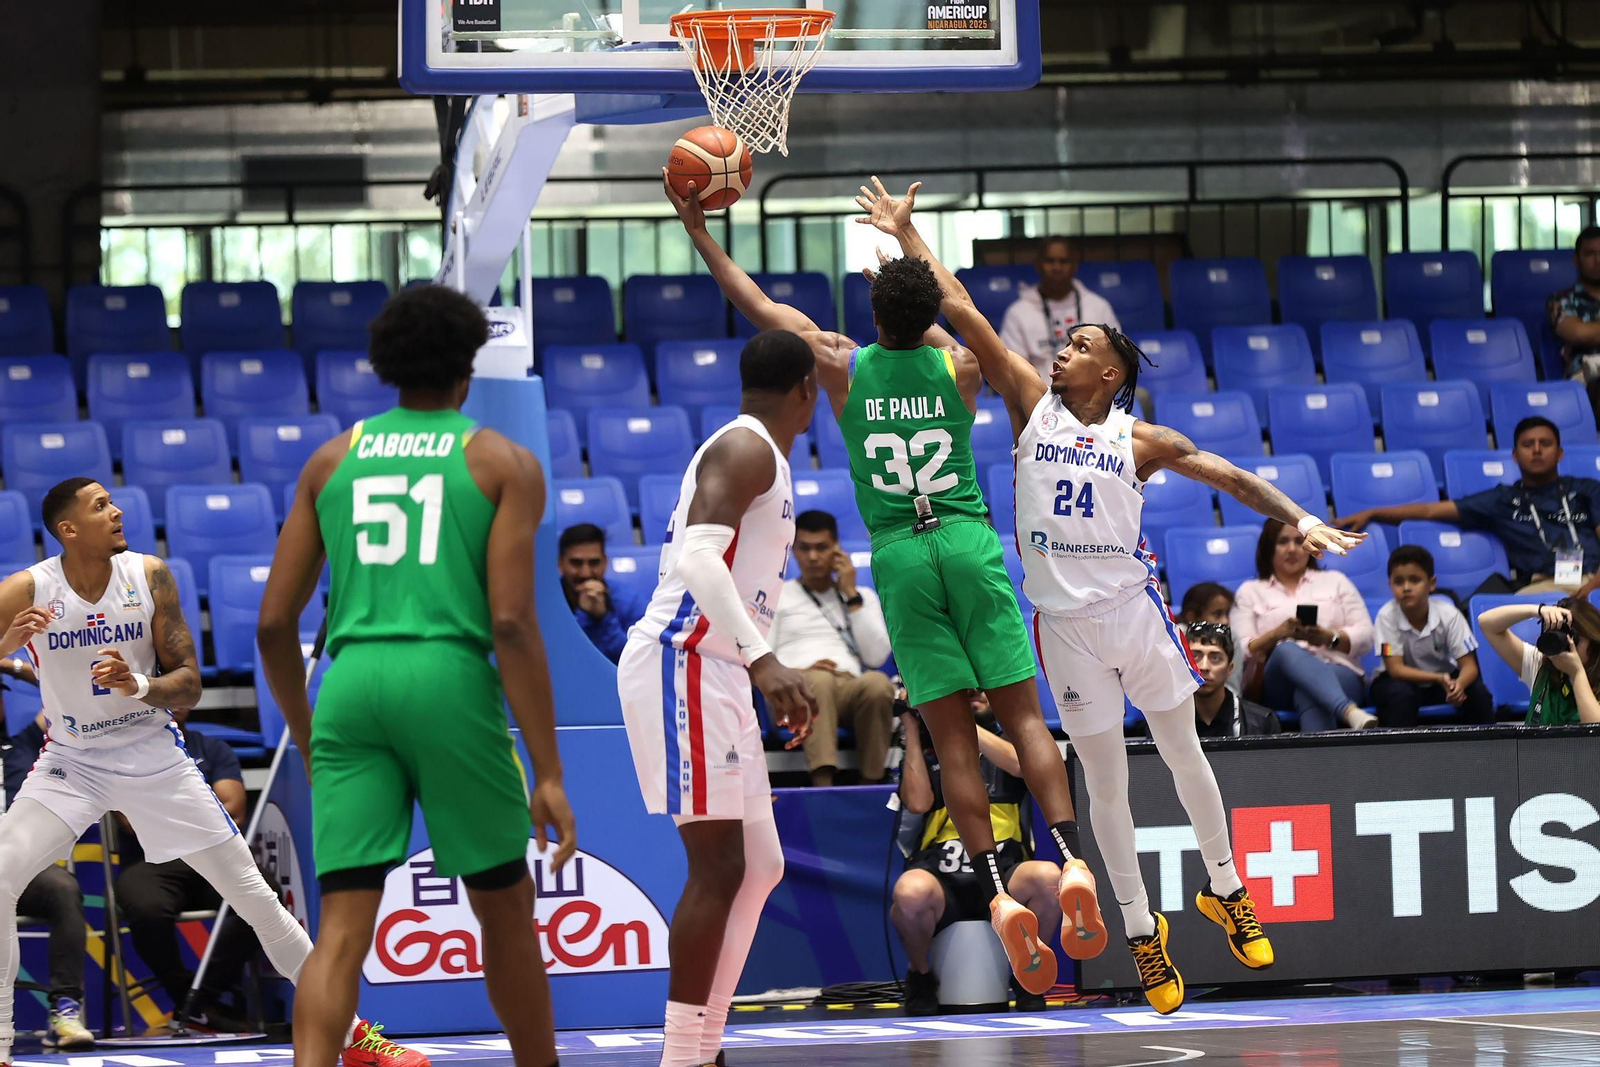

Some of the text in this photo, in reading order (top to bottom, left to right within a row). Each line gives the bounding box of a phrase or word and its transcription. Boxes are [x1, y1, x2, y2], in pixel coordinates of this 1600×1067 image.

[928, 5, 987, 19] AMERICUP
[928, 20, 988, 29] NICARAGUA 2025
[865, 395, 946, 421] DE PAULA
[357, 432, 455, 459] CABOCLO
[863, 428, 959, 495] 32
[1035, 443, 1125, 477] DOMINICANA
[1053, 479, 1095, 518] 24
[352, 473, 444, 566] 51
[1051, 541, 1130, 555] BANRESERVA
[49, 622, 143, 650] DOMINICANA
[82, 707, 157, 733] BANRESERVAS
[410, 857, 584, 907] 百山
[376, 900, 651, 977] Gaten
